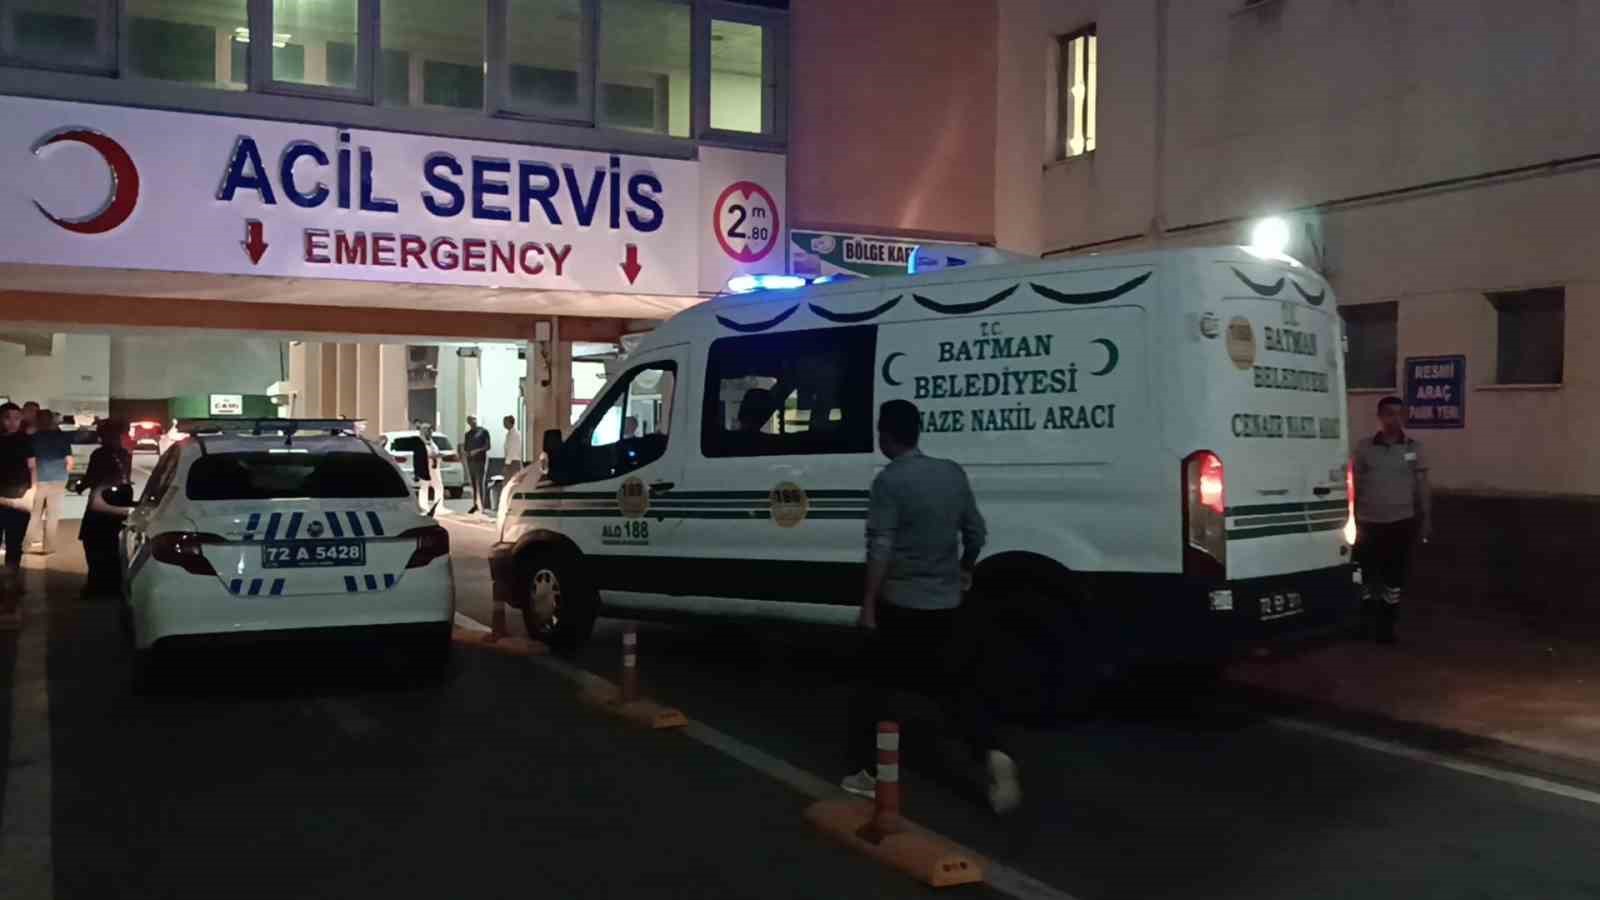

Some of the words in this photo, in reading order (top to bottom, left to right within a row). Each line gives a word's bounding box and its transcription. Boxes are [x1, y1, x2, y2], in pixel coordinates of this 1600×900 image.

[216, 127, 398, 213] ACİL
[421, 150, 664, 233] SERVİS
[727, 203, 747, 239] 2
[752, 206, 766, 219] m
[304, 228, 572, 276] EMERGENCY
[845, 239, 885, 262] BÖLGE
[938, 334, 1054, 362] BATMAN
[914, 363, 1079, 399] BELEDİYESİ
[971, 402, 1036, 431] NAKİL
[1043, 404, 1116, 430] ARACI
[623, 521, 649, 538] 188
[268, 548, 290, 561] 72
[296, 547, 309, 560] A
[315, 545, 360, 559] 5428
